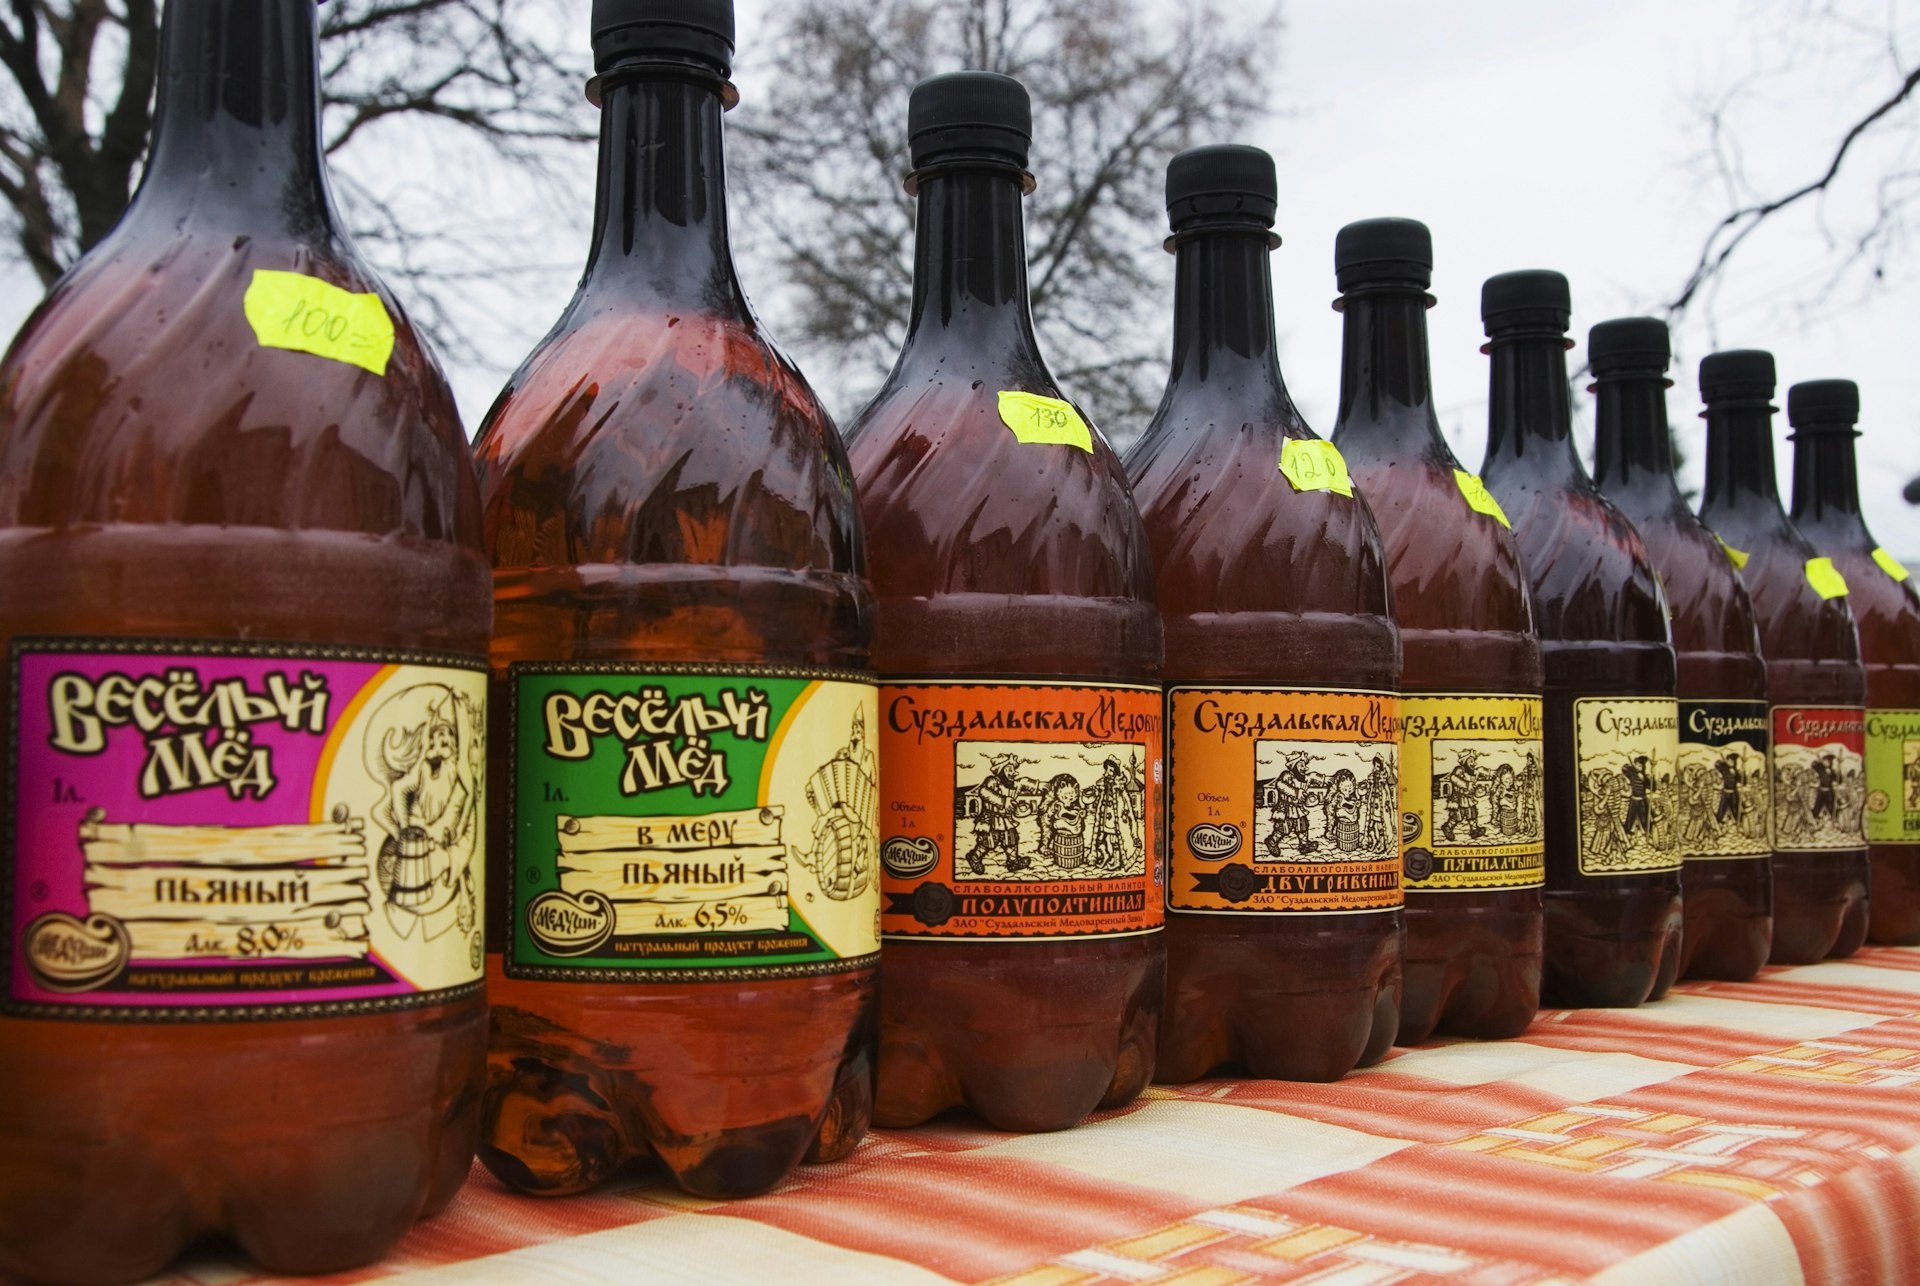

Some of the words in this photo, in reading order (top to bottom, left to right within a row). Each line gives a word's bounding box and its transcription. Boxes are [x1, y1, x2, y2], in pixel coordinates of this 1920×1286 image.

[1030, 408, 1068, 429] 130
[1290, 453, 1336, 479] 120
[888, 696, 1086, 745] Суздальская
[1194, 699, 1360, 743] Суздальская
[1197, 793, 1230, 802] Объем
[1254, 865, 1373, 874] СЛАБОАЛКОГОЛЬНЫЙ
[1432, 874, 1451, 882] ЗАО
[953, 882, 1103, 894] СЛАБОАЛКОГОЛЬНЫЙ
[1108, 881, 1146, 891] НАПИТОК
[961, 895, 1142, 917] ПОЛУПОЛТИННАЯ
[1253, 896, 1275, 904] ЗАО
[695, 902, 748, 931] 6,5%
[953, 919, 977, 928] ЗАО
[1059, 915, 1126, 928] Медоваренный
[236, 923, 303, 957] 8,0%
[615, 940, 700, 956] натуральный
[704, 941, 753, 955] продукт
